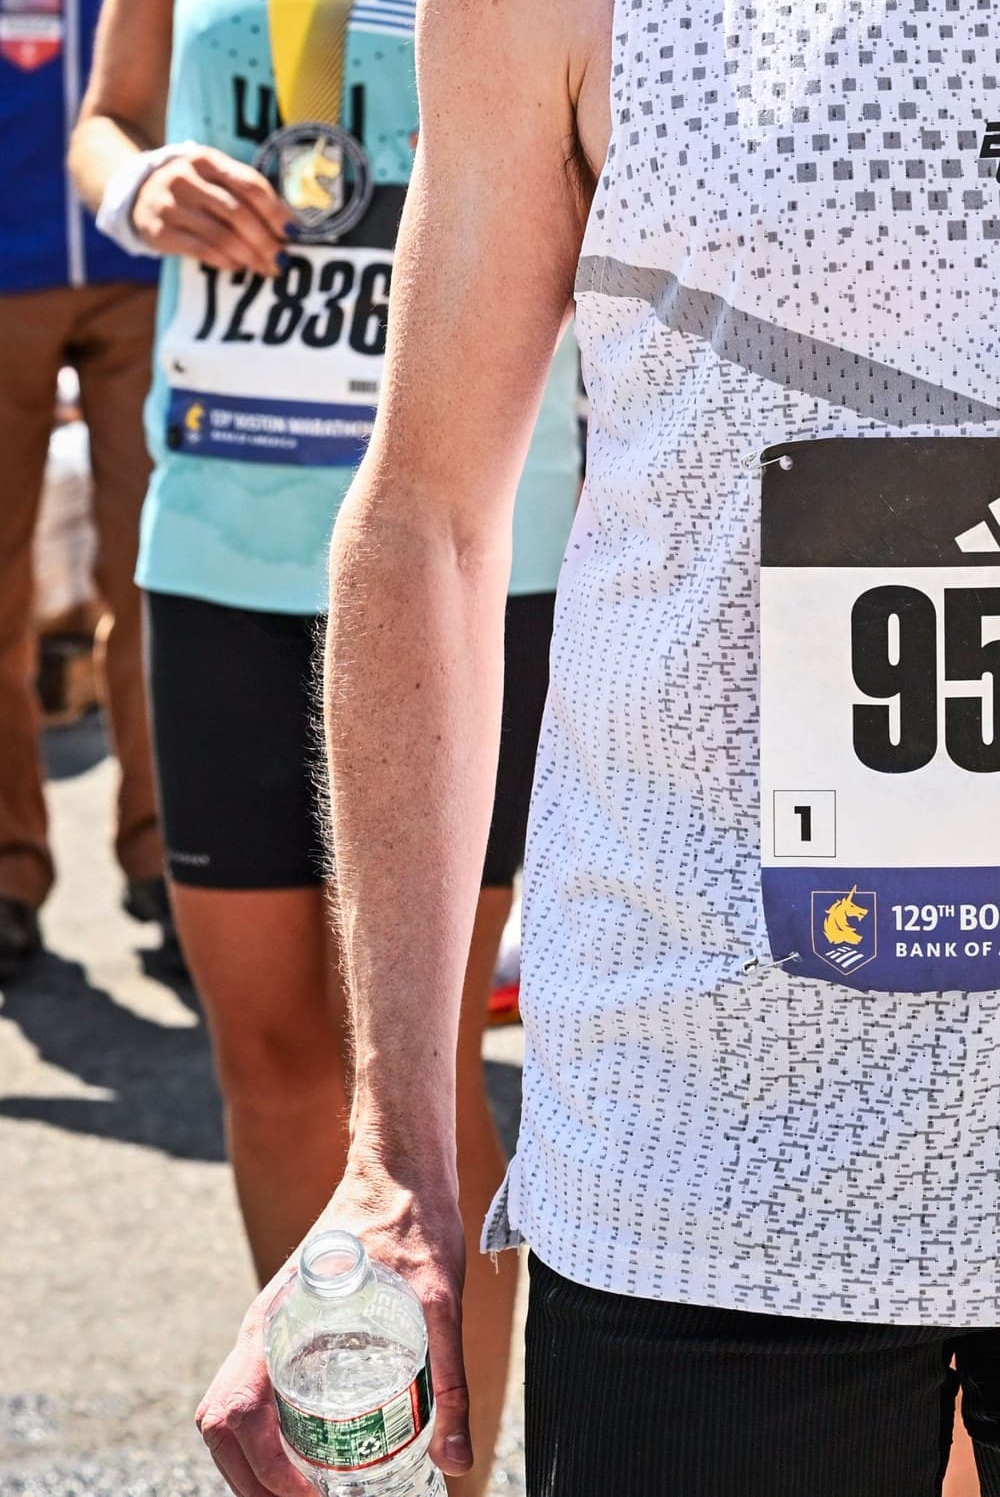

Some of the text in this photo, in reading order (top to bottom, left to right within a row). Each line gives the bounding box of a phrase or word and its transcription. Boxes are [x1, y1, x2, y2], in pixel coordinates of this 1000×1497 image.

[194, 254, 393, 356] 12836
[794, 805, 812, 842] 1
[891, 904, 955, 932] 129TH
[895, 942, 958, 958] BANK
[964, 941, 993, 957] OF
